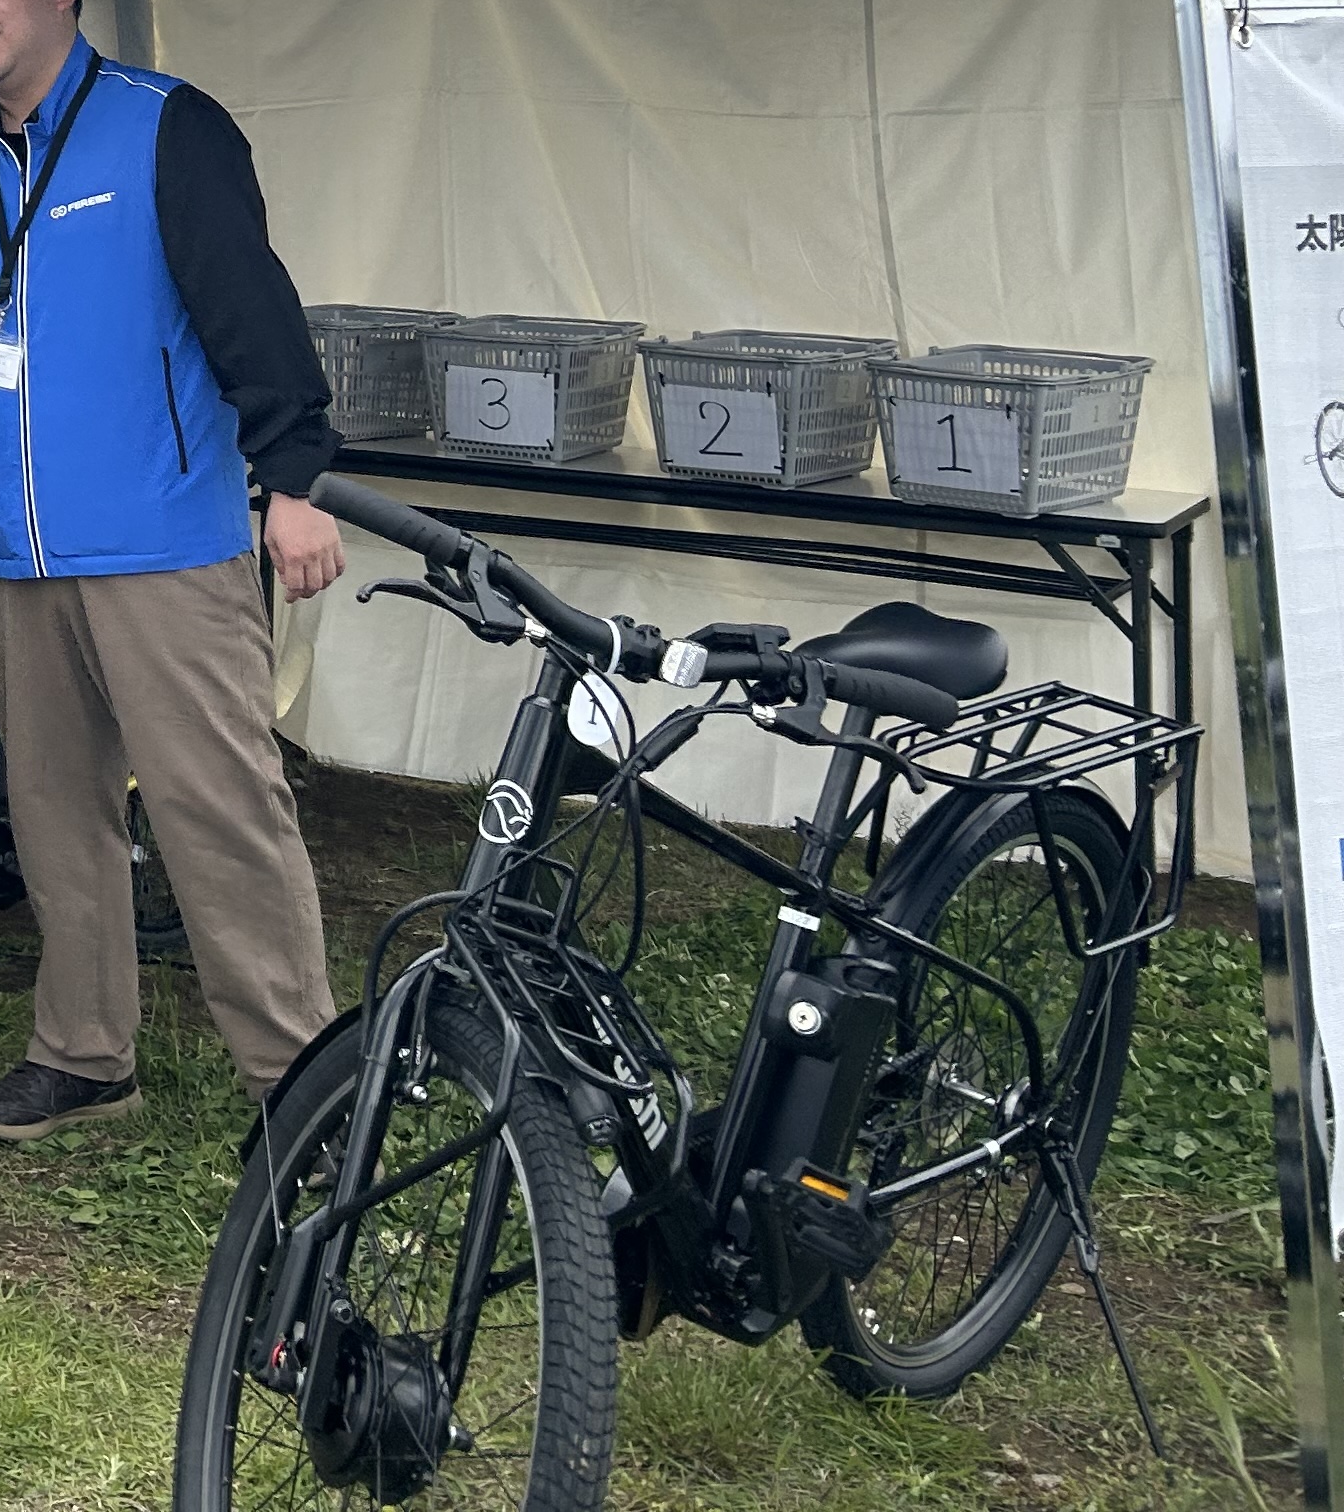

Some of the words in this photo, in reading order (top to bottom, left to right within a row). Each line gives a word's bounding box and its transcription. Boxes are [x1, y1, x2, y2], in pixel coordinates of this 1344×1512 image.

[478, 377, 511, 430] 3
[698, 401, 744, 457] 2
[936, 413, 972, 474] 1
